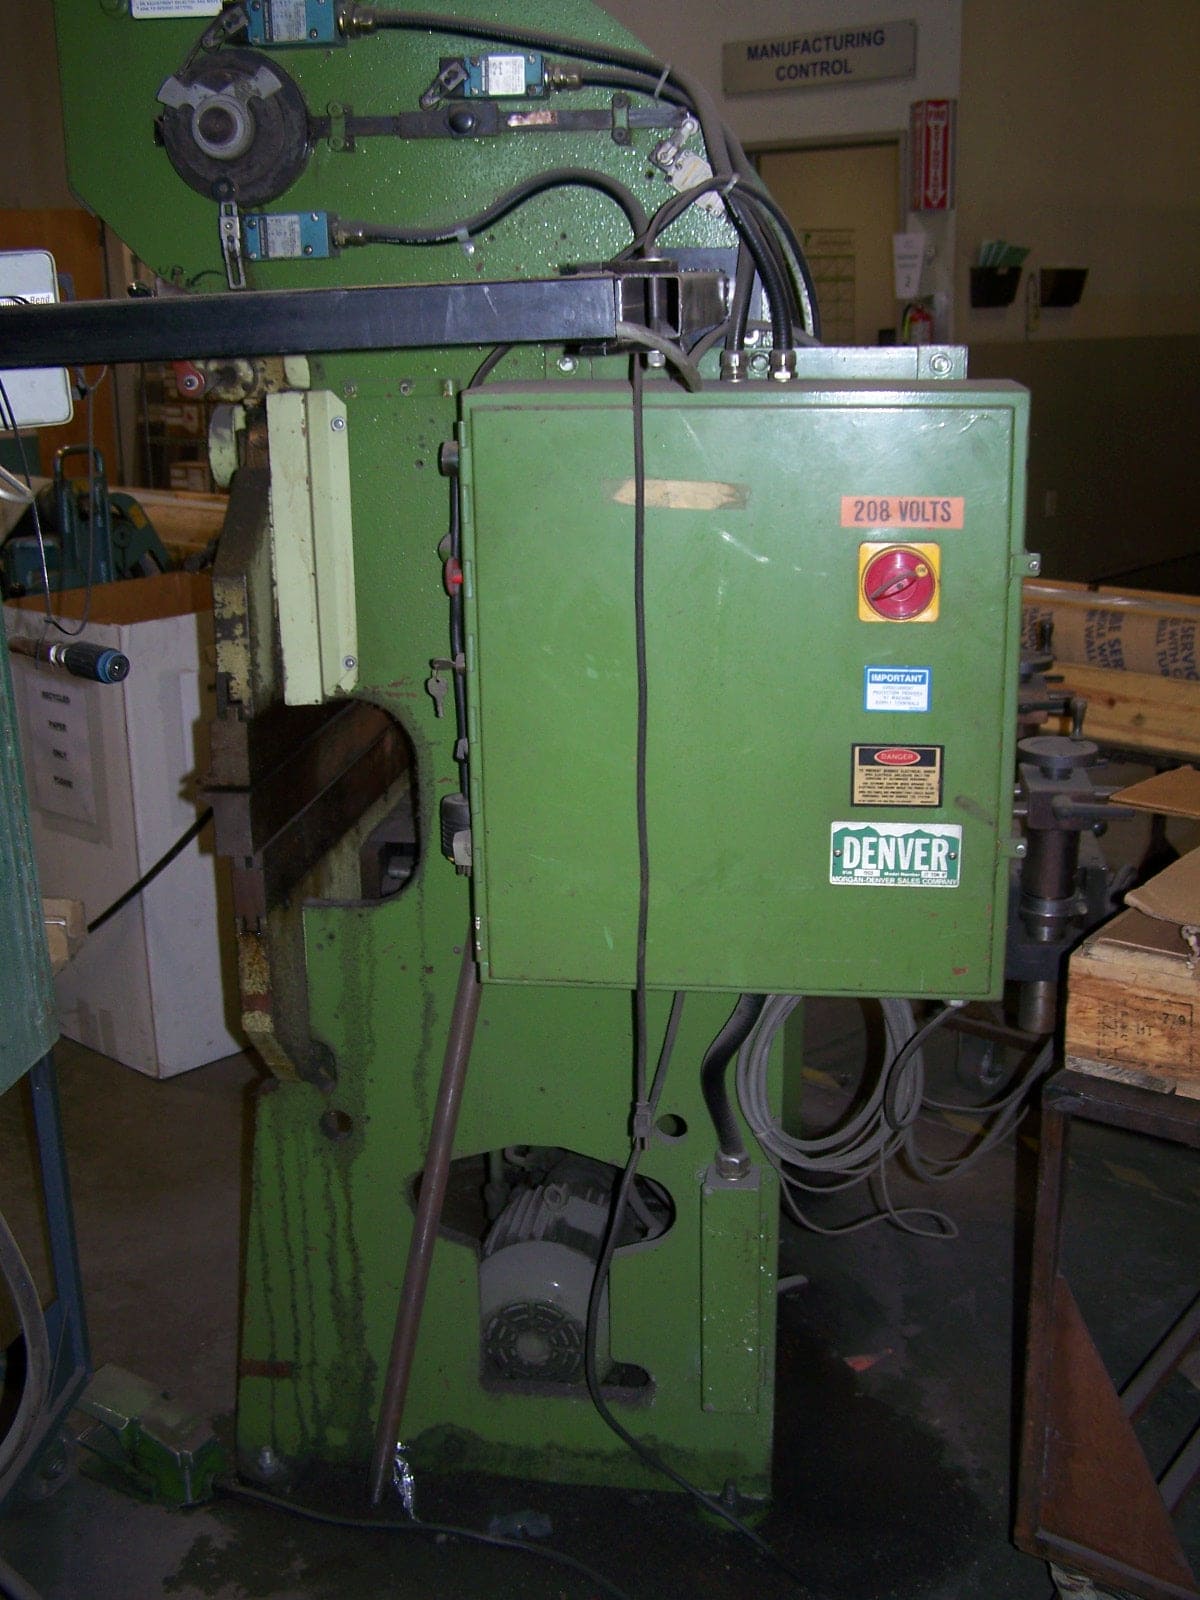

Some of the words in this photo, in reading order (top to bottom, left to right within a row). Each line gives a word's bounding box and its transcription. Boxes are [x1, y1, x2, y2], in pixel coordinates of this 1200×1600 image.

[747, 30, 885, 61] MANUFACTURING
[776, 59, 853, 81] CONTROL
[854, 500, 890, 522] 208
[898, 500, 953, 522] VOLTS
[871, 673, 923, 683] IMPORTANT
[842, 836, 949, 871] DENVER
[897, 877, 920, 885] SALES
